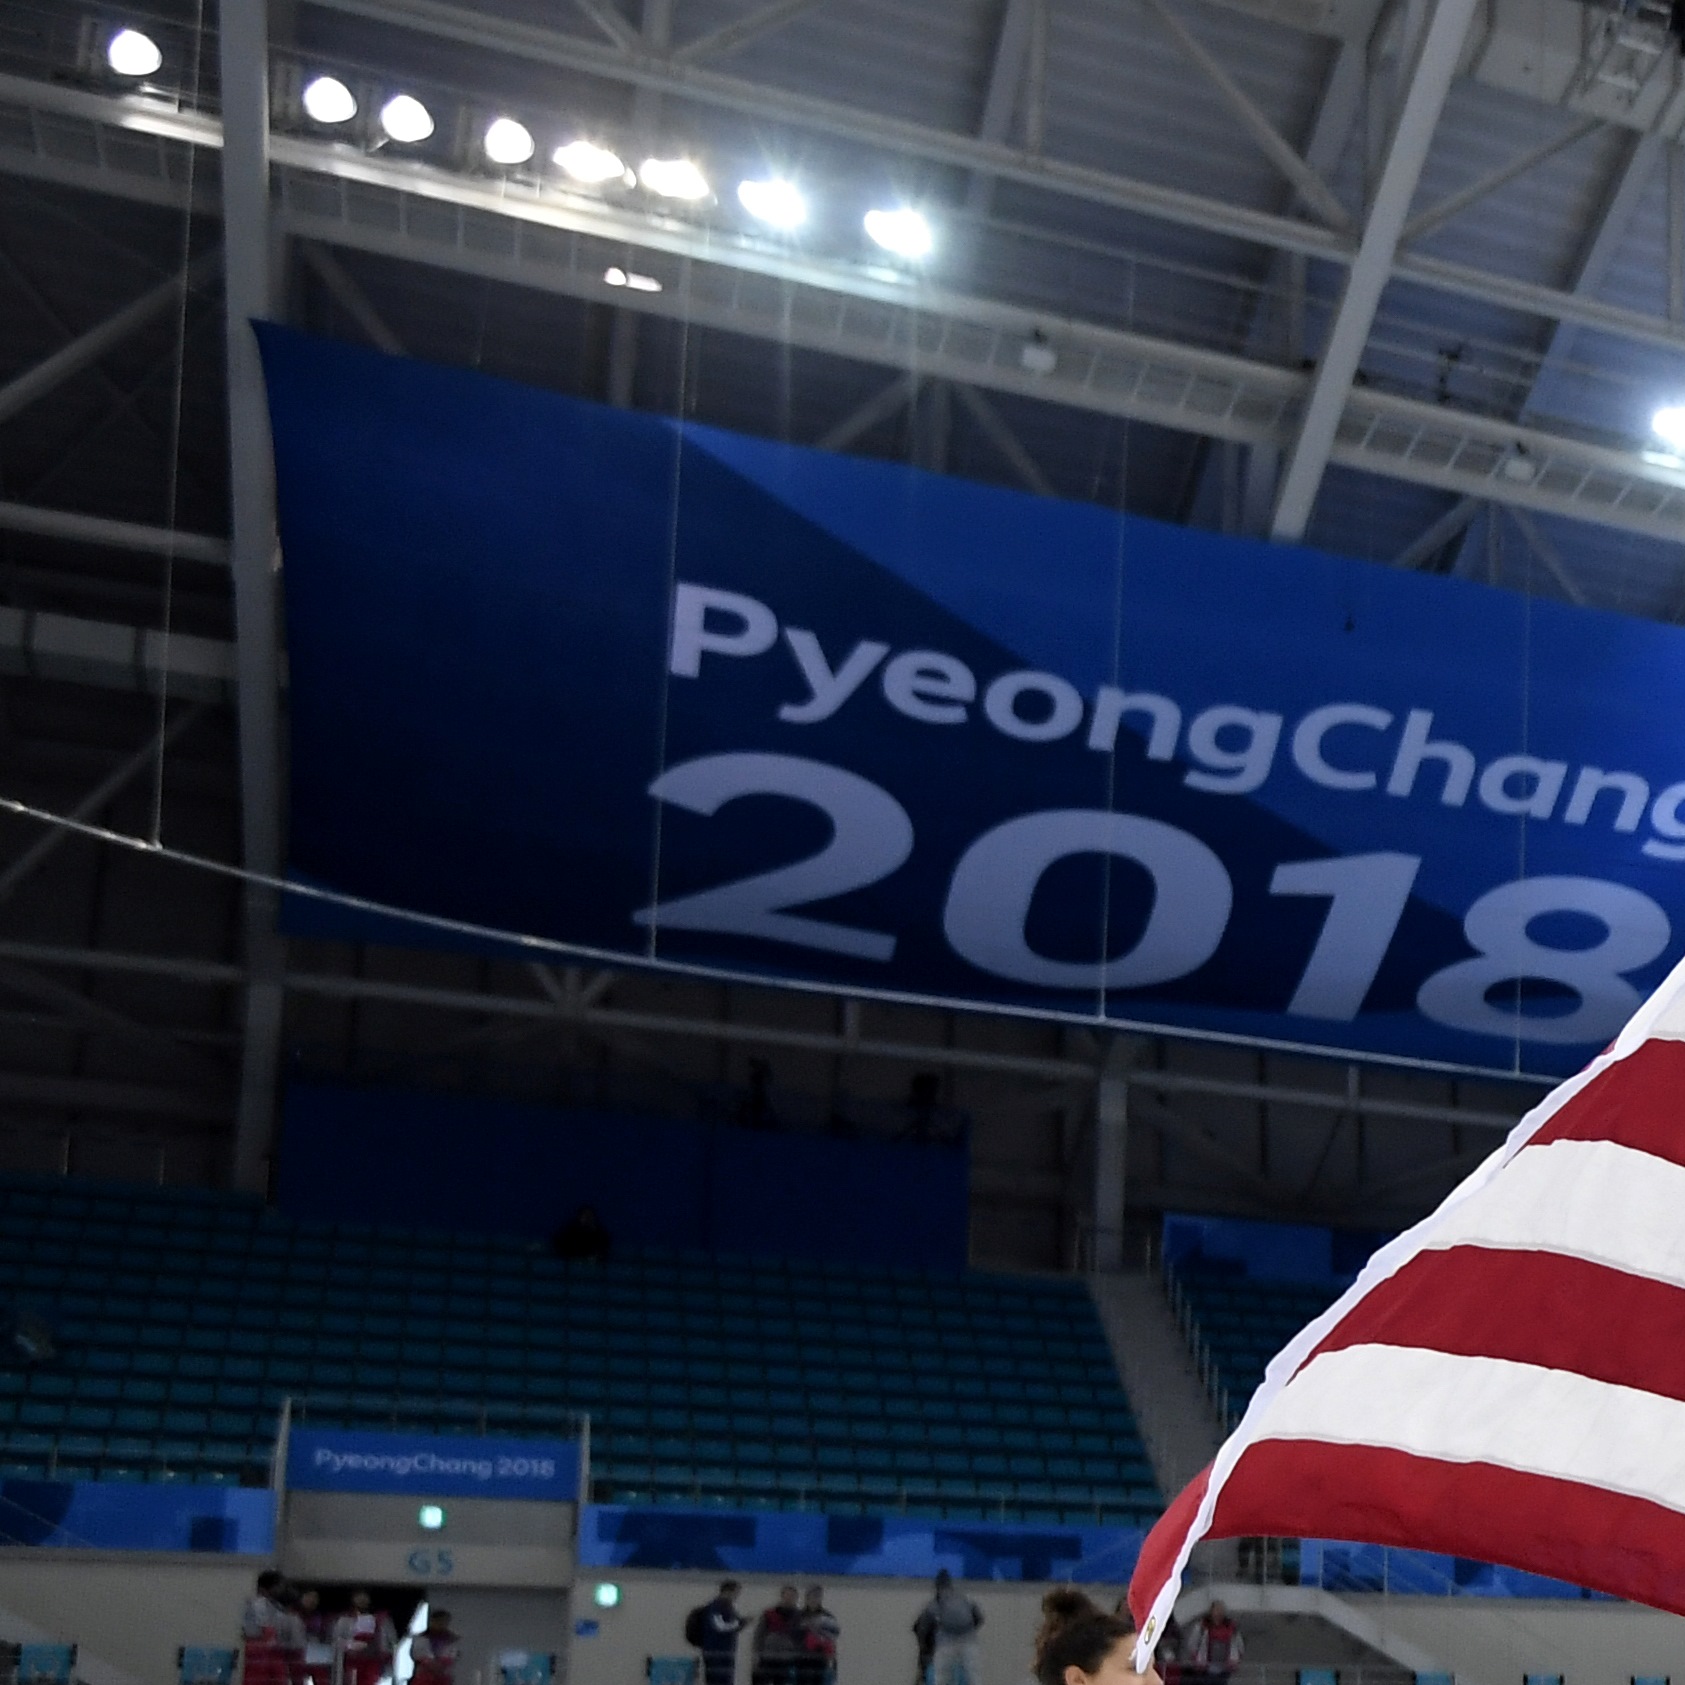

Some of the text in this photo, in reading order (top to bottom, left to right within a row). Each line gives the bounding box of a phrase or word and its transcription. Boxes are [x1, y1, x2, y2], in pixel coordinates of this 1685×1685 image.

[631, 752, 1672, 1044] 2018
[315, 1448, 556, 1481] PyeongChang 2018
